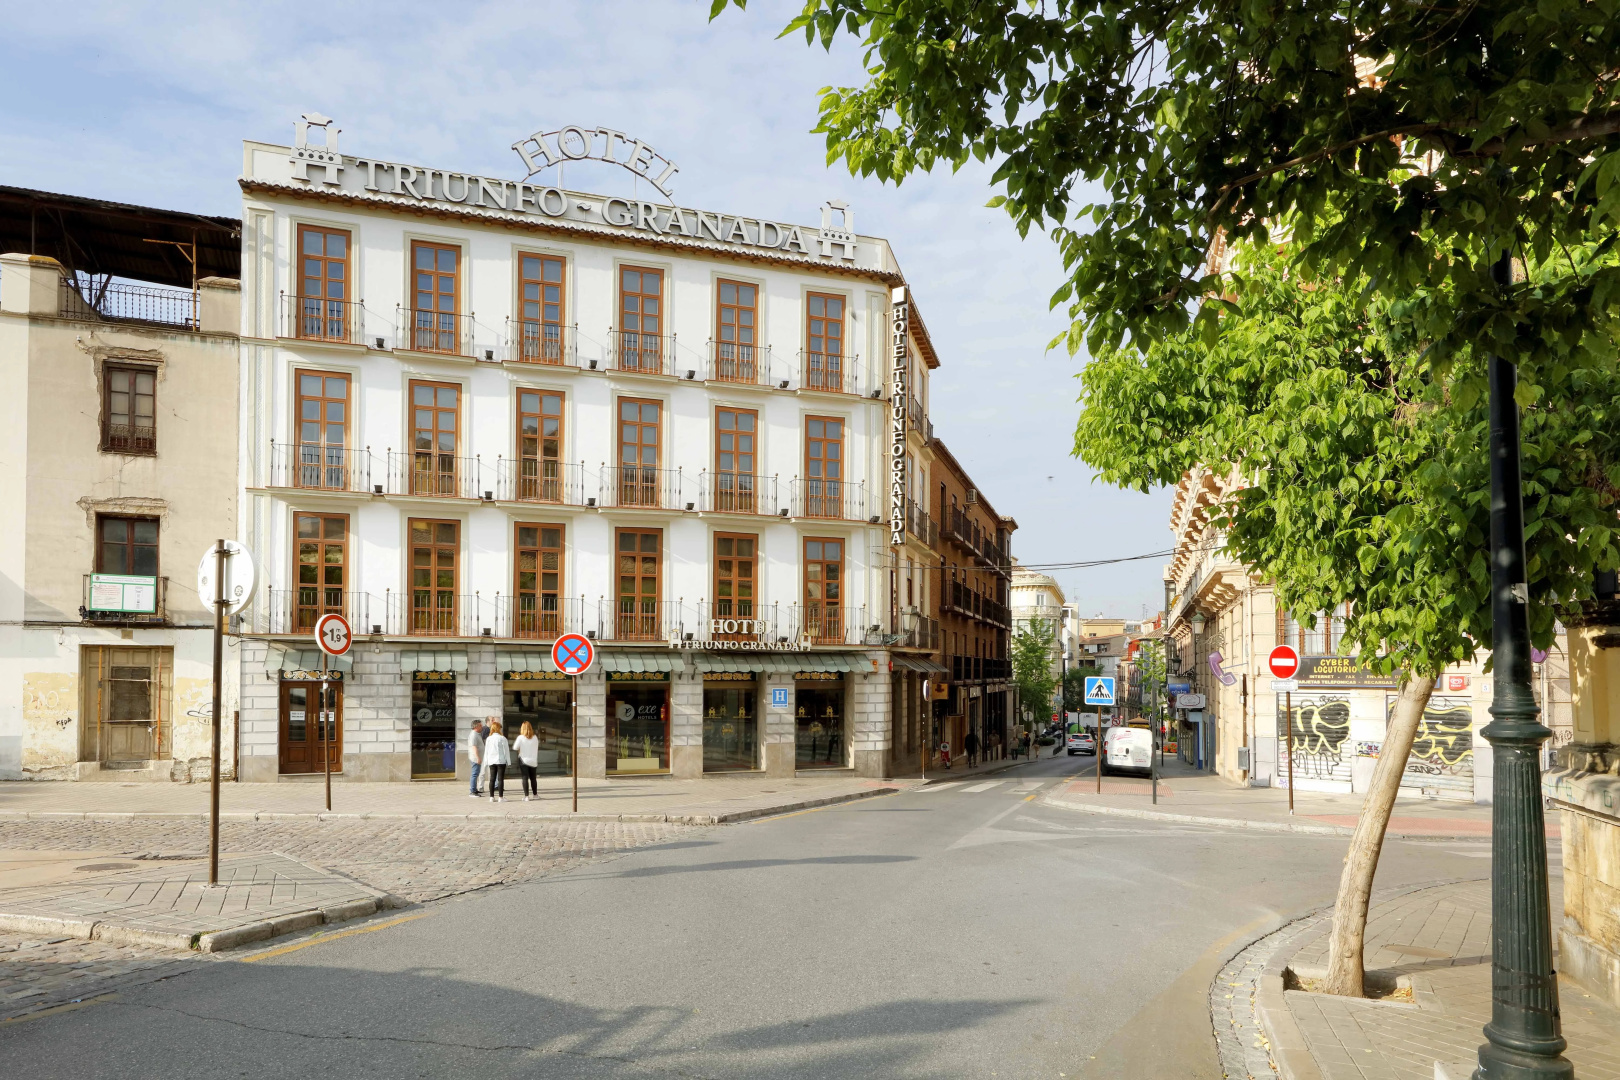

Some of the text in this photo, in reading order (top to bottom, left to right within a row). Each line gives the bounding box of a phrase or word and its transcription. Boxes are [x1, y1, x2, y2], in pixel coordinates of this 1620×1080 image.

[512, 125, 680, 196] HOTEL
[356, 158, 569, 217] TRIUNFO
[602, 197, 809, 254] GRANADA
[891, 307, 906, 544] HOTEL TRIUNFO GRANADA
[711, 619, 773, 634] HOTEL
[683, 640, 739, 650] TRIUNFO
[740, 640, 800, 651] GRANADA
[1320, 658, 1350, 666] CYBER
[775, 690, 786, 702] H
